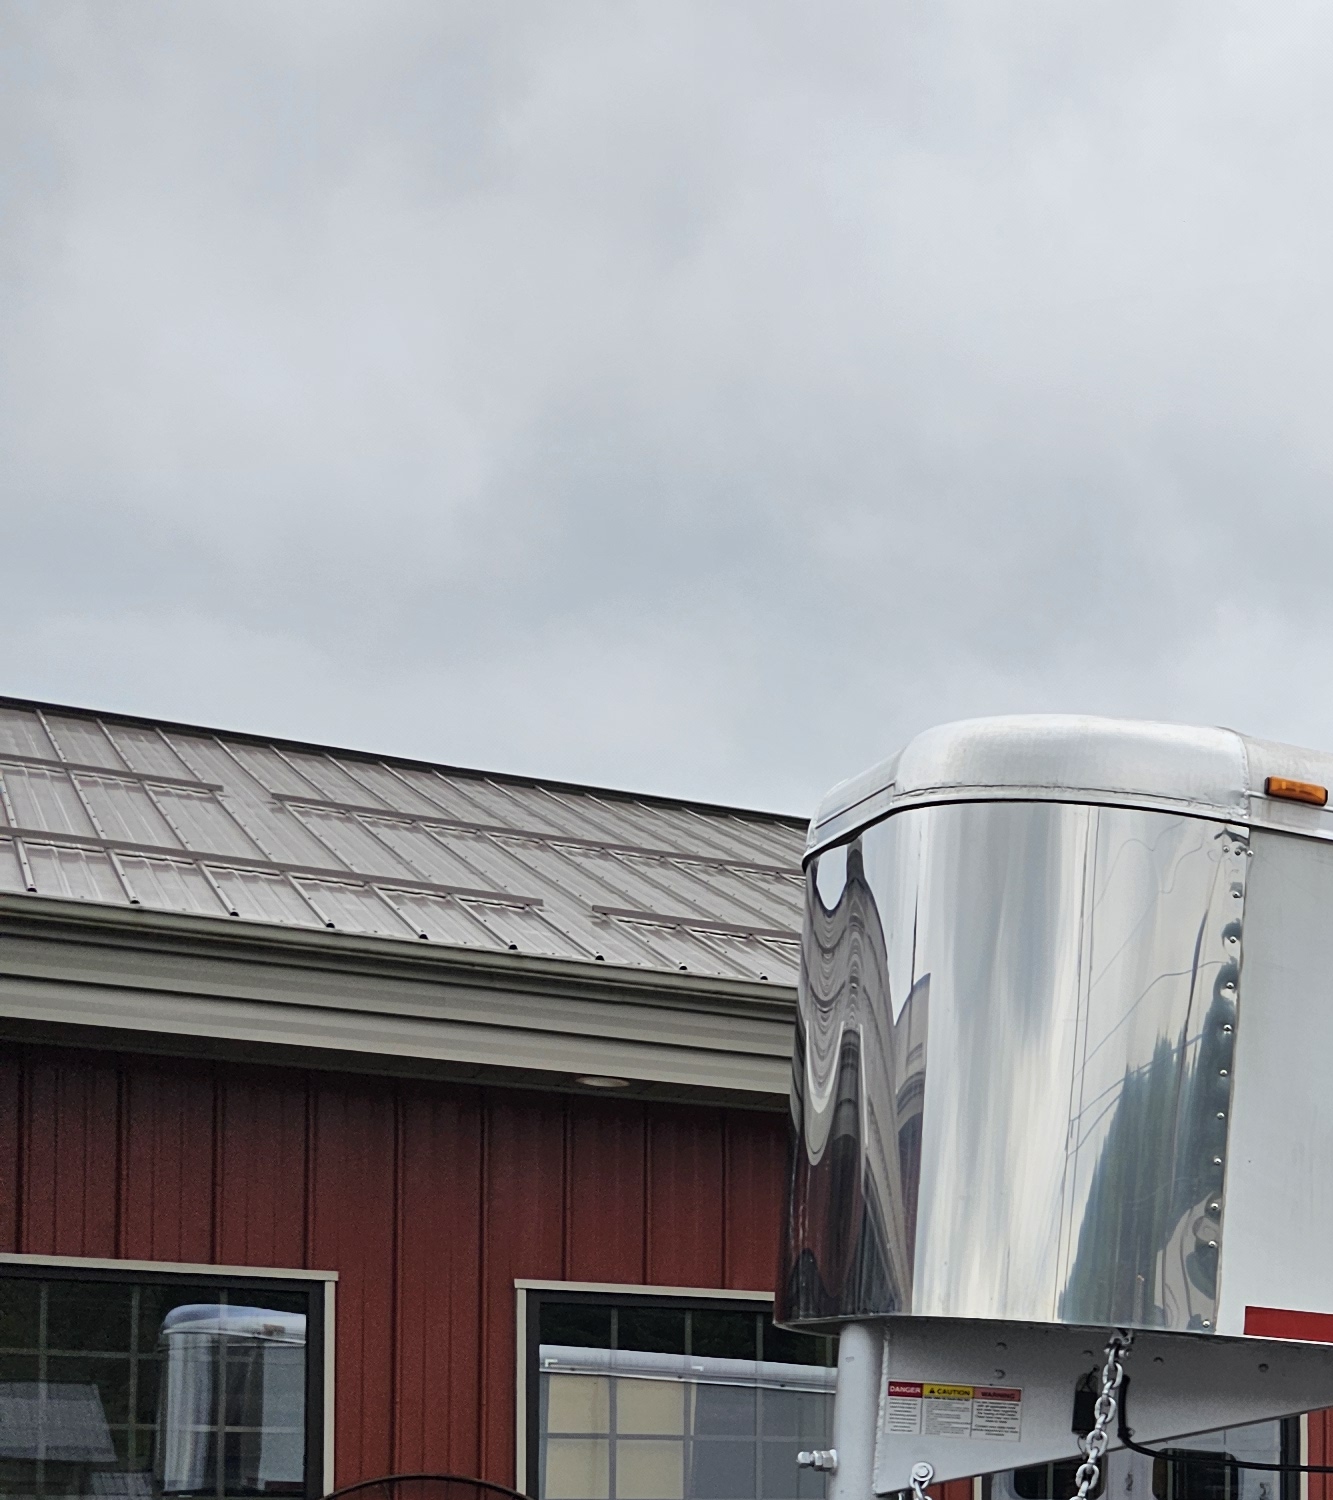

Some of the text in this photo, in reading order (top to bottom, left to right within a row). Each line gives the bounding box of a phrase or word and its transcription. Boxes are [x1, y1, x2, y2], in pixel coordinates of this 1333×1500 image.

[889, 1385, 921, 1393] DANGER
[937, 1387, 971, 1396] CAUTION
[981, 1391, 1016, 1399] WARNING
